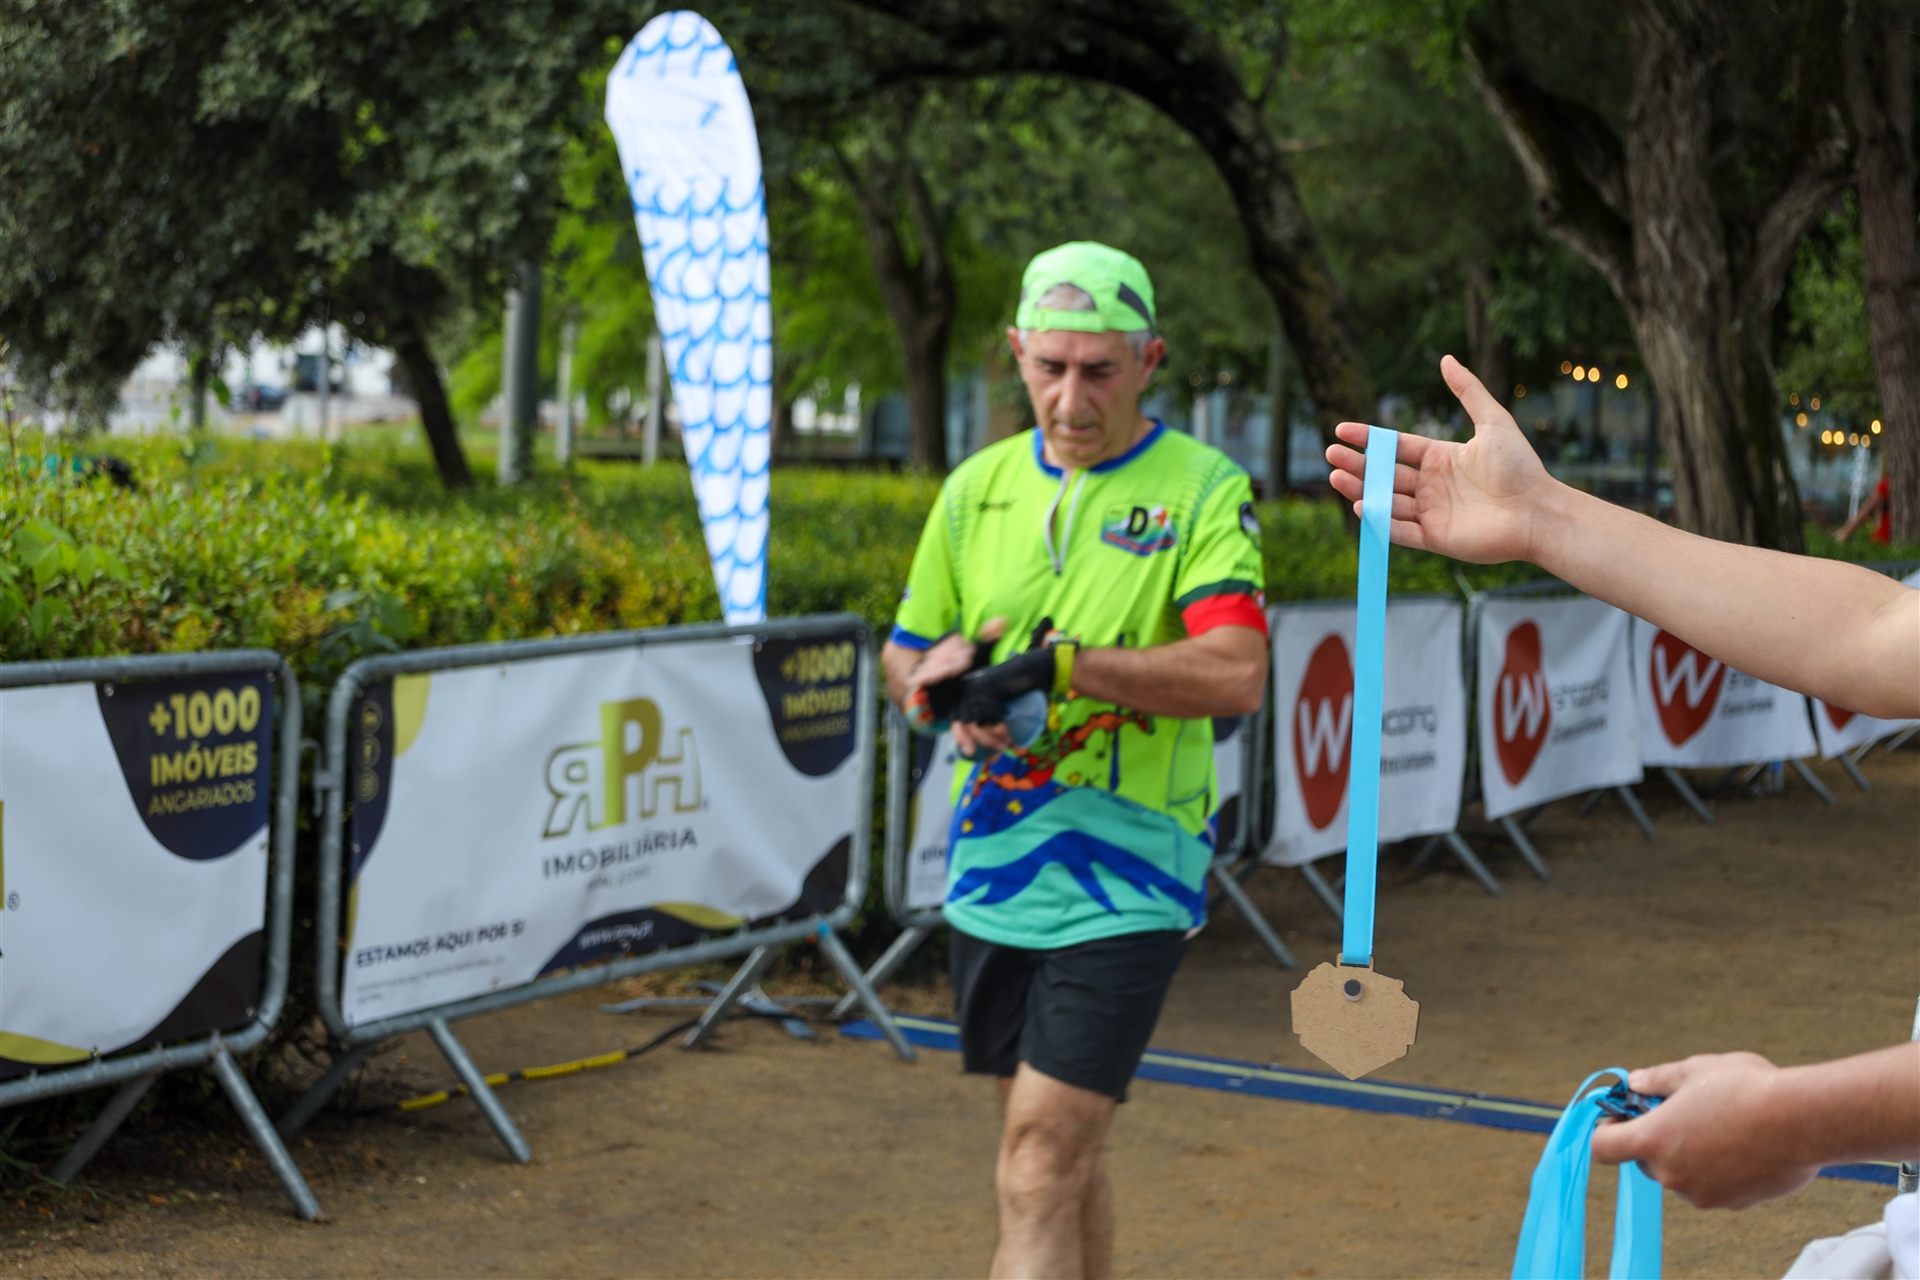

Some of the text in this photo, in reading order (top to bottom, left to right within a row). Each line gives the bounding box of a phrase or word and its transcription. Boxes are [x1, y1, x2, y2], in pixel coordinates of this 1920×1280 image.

[149, 685, 261, 740] +1000
[1502, 670, 1546, 743] W
[1301, 692, 1354, 779] W
[150, 741, 258, 787] IMÓVEIS
[148, 780, 256, 817] ANGARIADOS
[542, 827, 697, 880] IMOBILIÁRIA
[356, 936, 431, 968] ESTAMOS
[435, 929, 474, 953] AQUI
